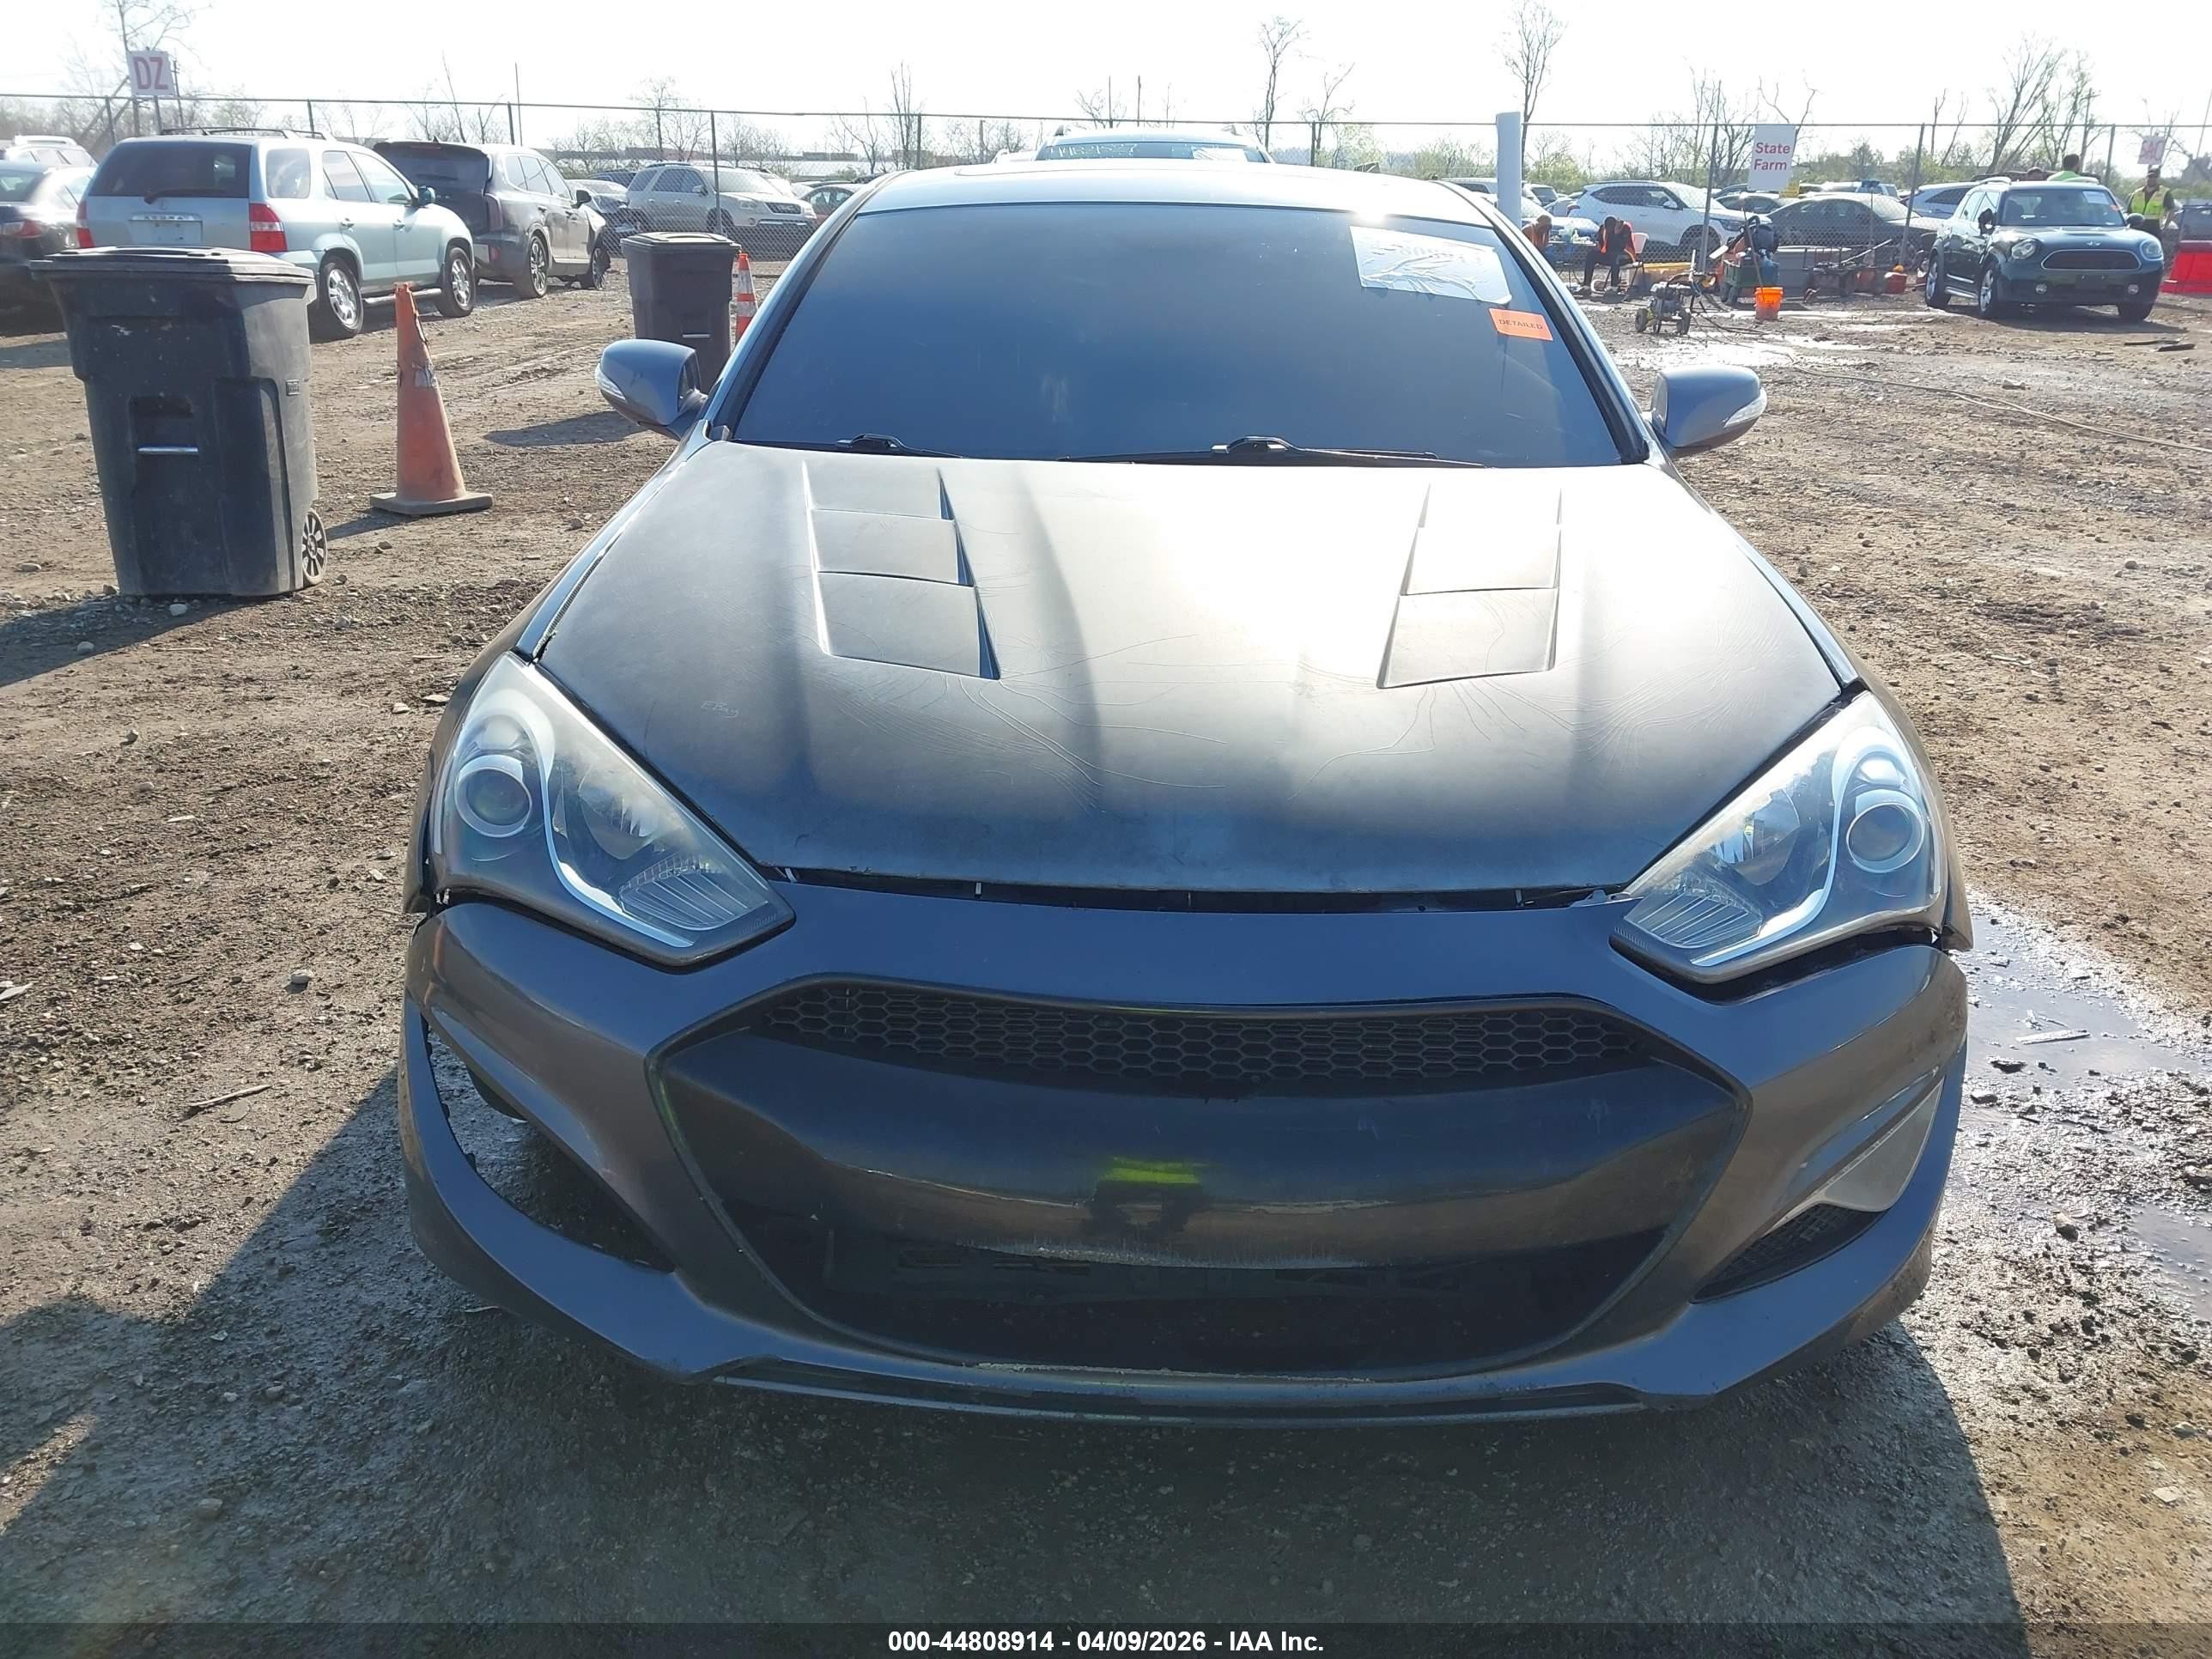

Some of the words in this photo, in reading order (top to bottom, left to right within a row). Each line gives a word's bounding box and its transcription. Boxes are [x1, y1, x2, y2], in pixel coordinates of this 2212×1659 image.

[133, 56, 168, 90] DZ
[1755, 142, 1790, 155] State
[1753, 158, 1787, 171] Farm
[1498, 318, 1544, 330] DETAILED
